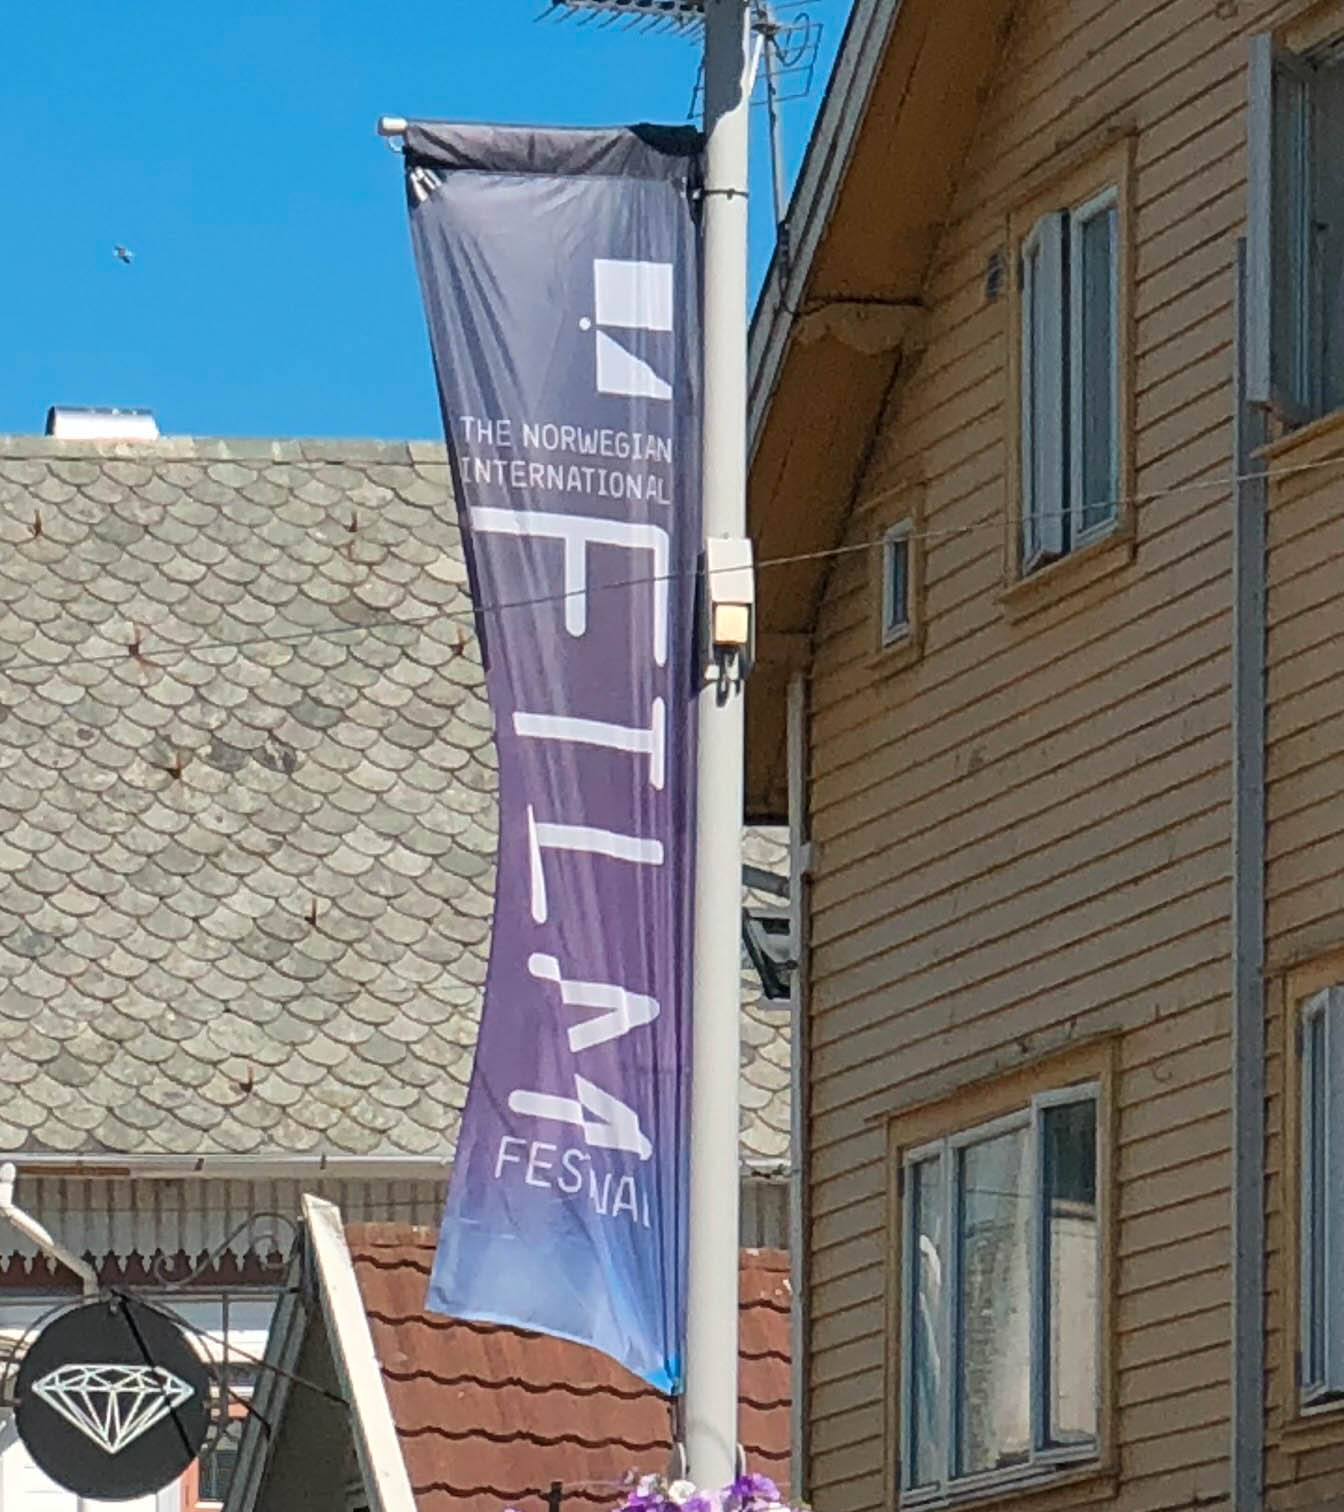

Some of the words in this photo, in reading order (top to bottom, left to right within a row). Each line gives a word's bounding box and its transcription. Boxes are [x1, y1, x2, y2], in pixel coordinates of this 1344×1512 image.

[460, 416, 512, 447] THE
[522, 423, 673, 463] NORWEGIAN
[461, 457, 672, 505] INTERNATIONAL
